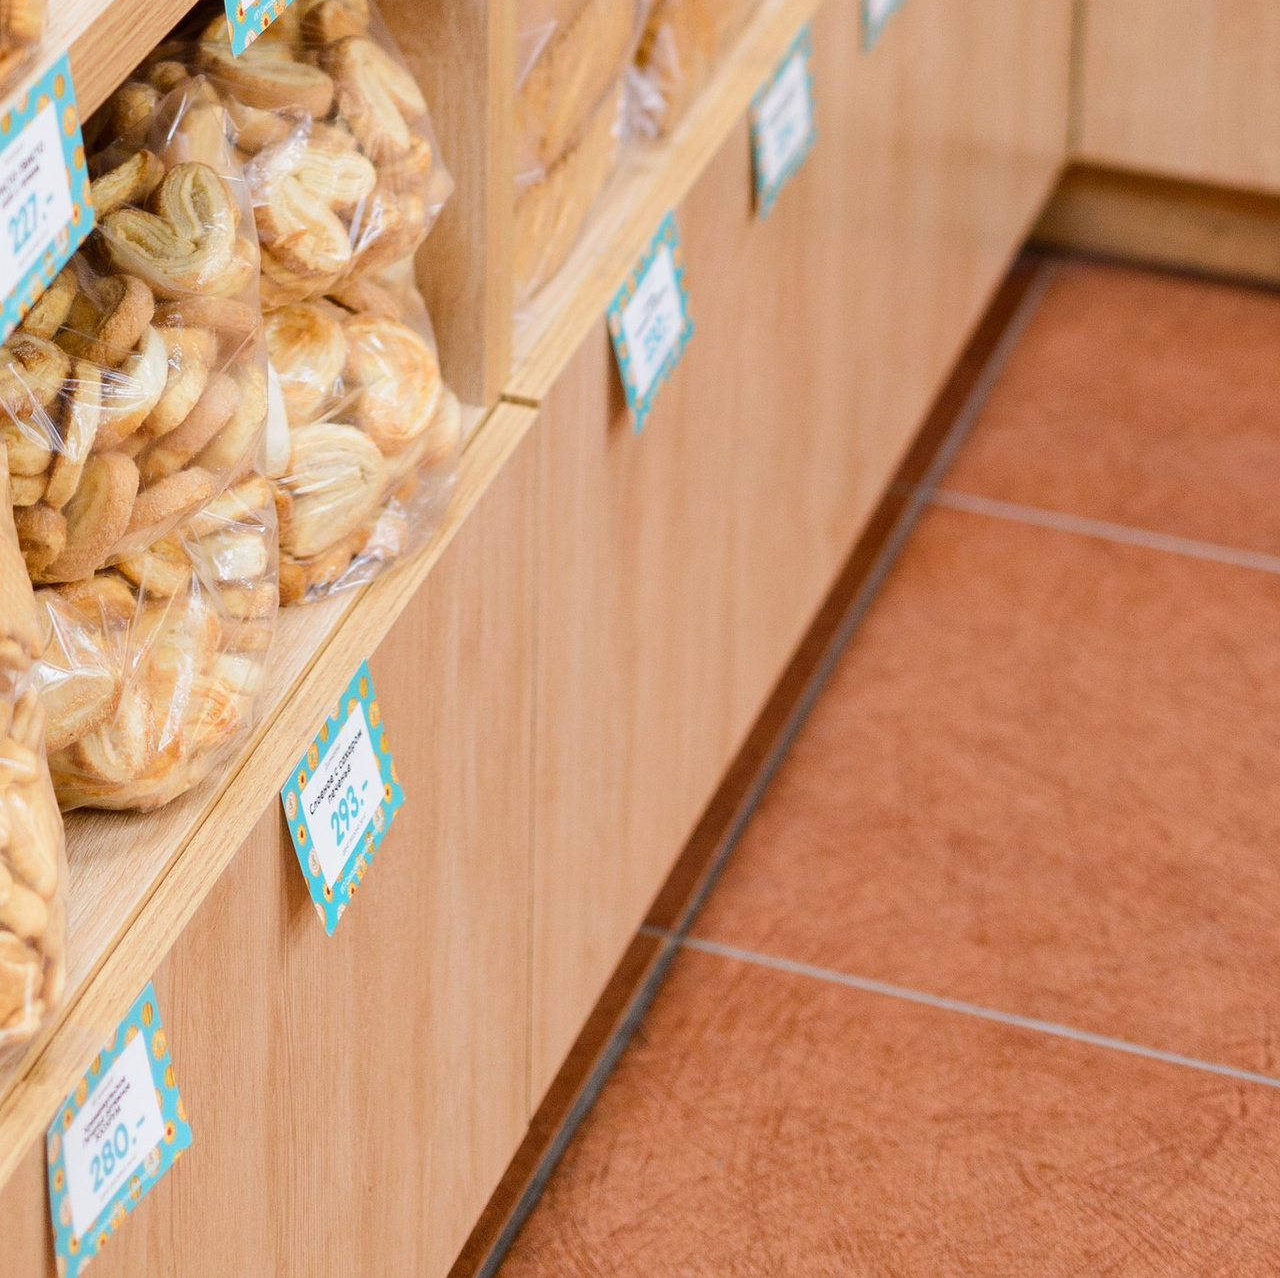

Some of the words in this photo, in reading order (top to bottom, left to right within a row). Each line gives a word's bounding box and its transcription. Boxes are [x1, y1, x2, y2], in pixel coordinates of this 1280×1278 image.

[9, 192, 54, 255] 227.-
[338, 729, 363, 770] сахаром
[331, 780, 368, 847] 293.-
[90, 1115, 146, 1195] 280.-
